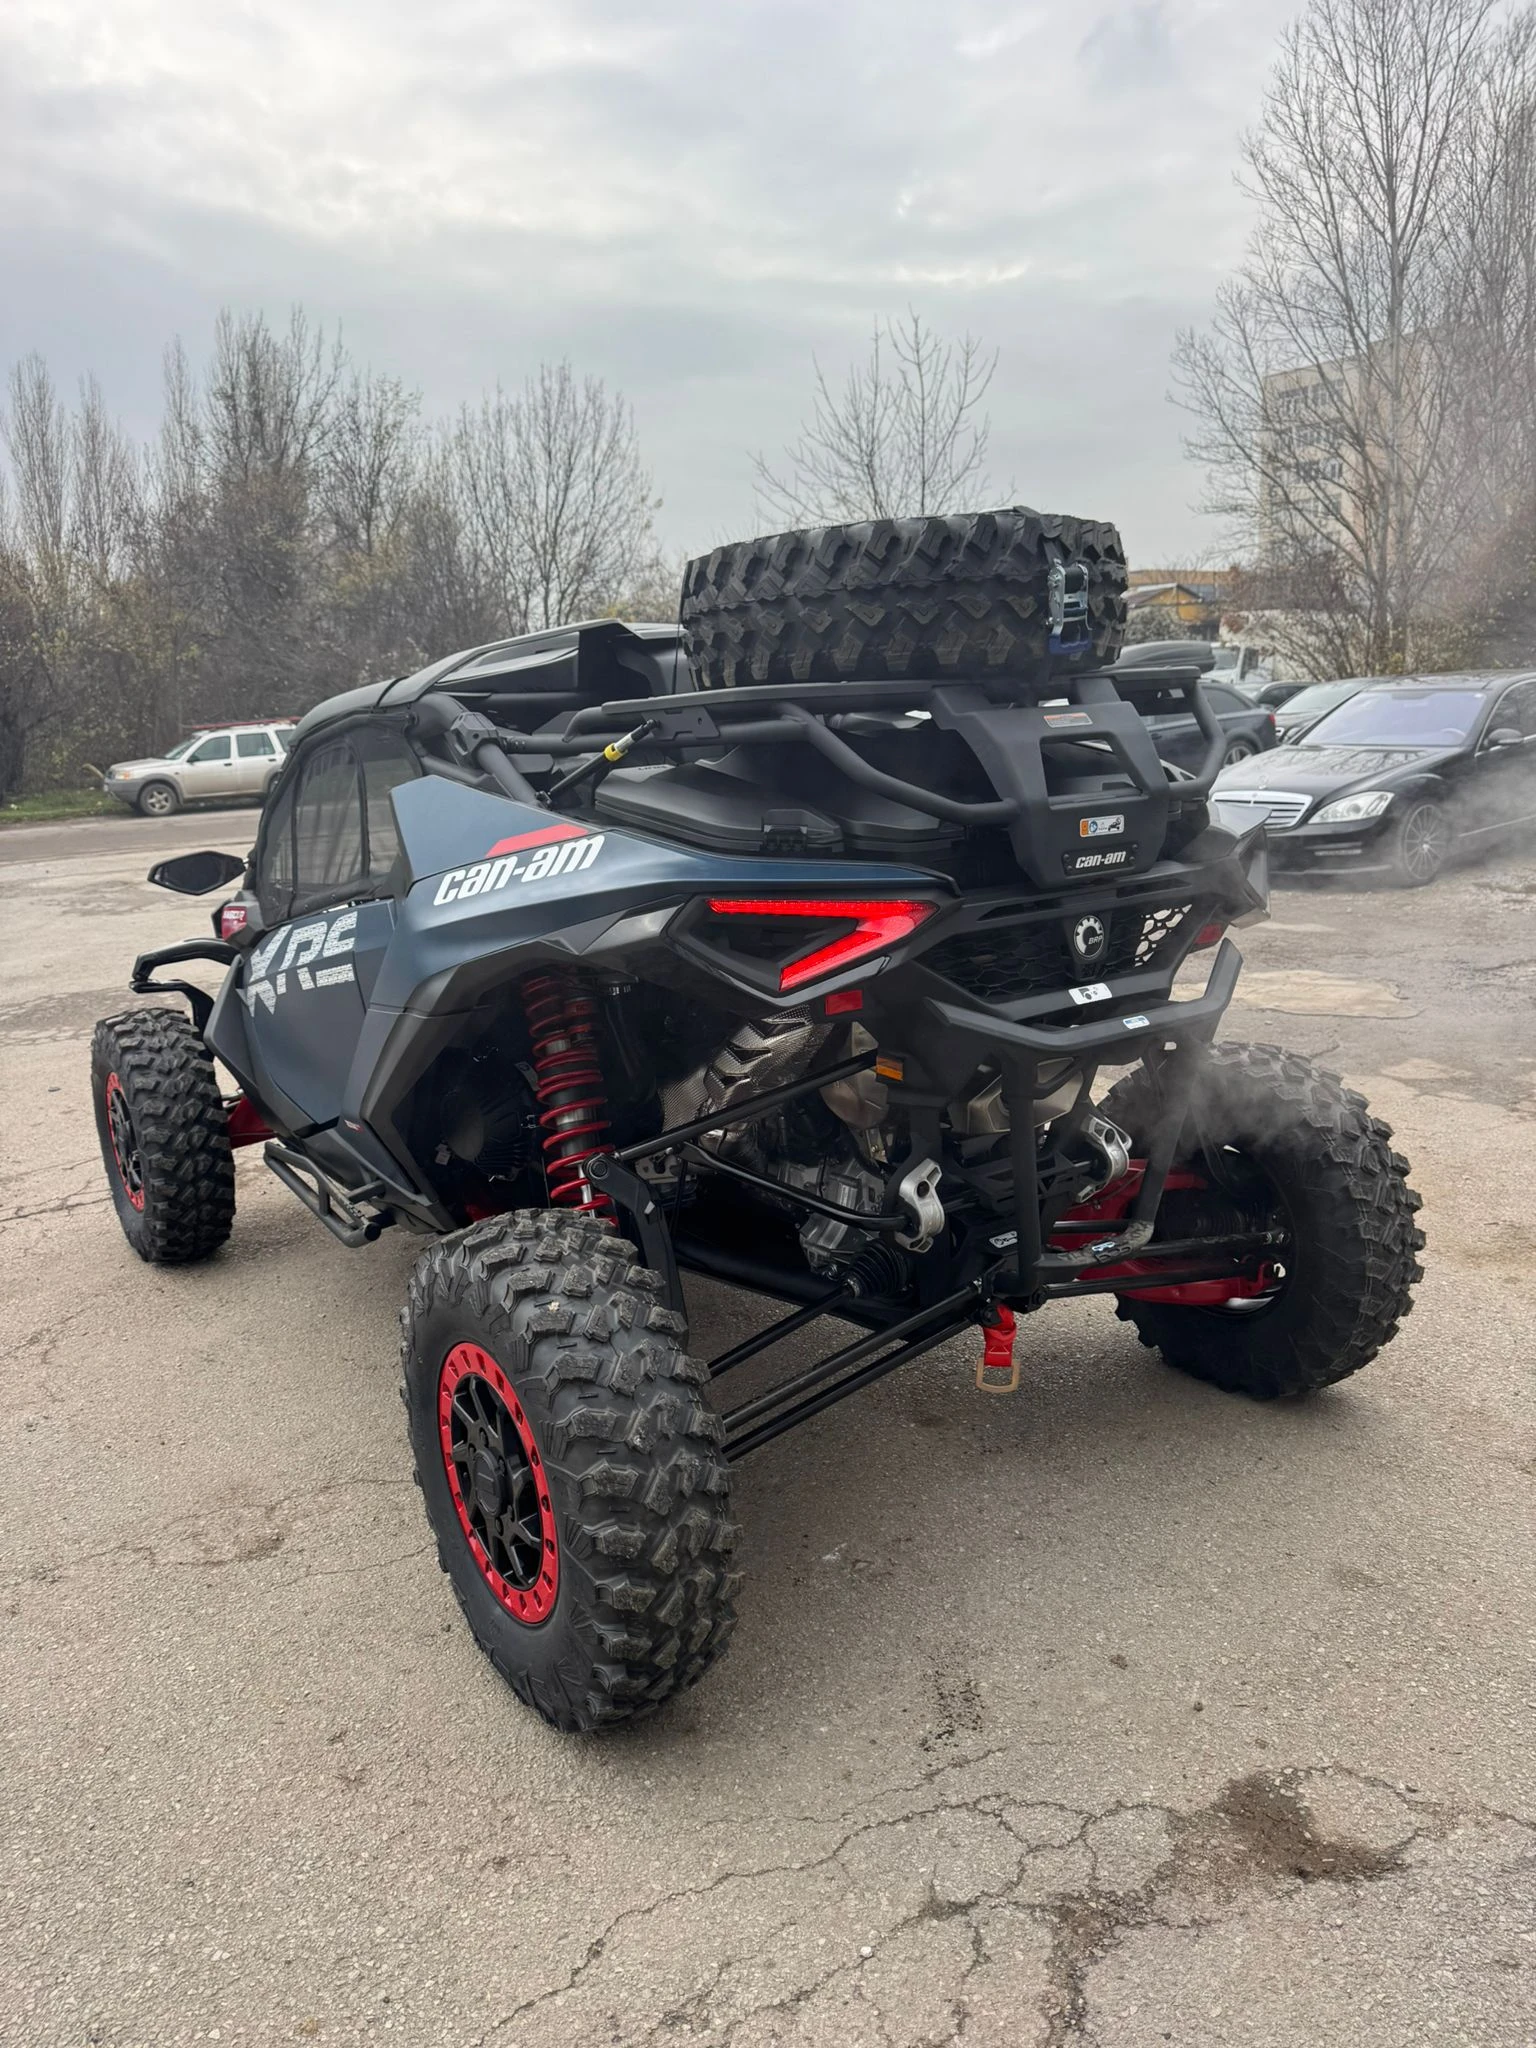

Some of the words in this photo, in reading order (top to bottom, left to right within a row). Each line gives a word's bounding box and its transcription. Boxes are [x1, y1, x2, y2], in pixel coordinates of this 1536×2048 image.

[1075, 851, 1127, 869] can-am
[433, 835, 605, 906] can-am
[1088, 935, 1103, 945] BRP
